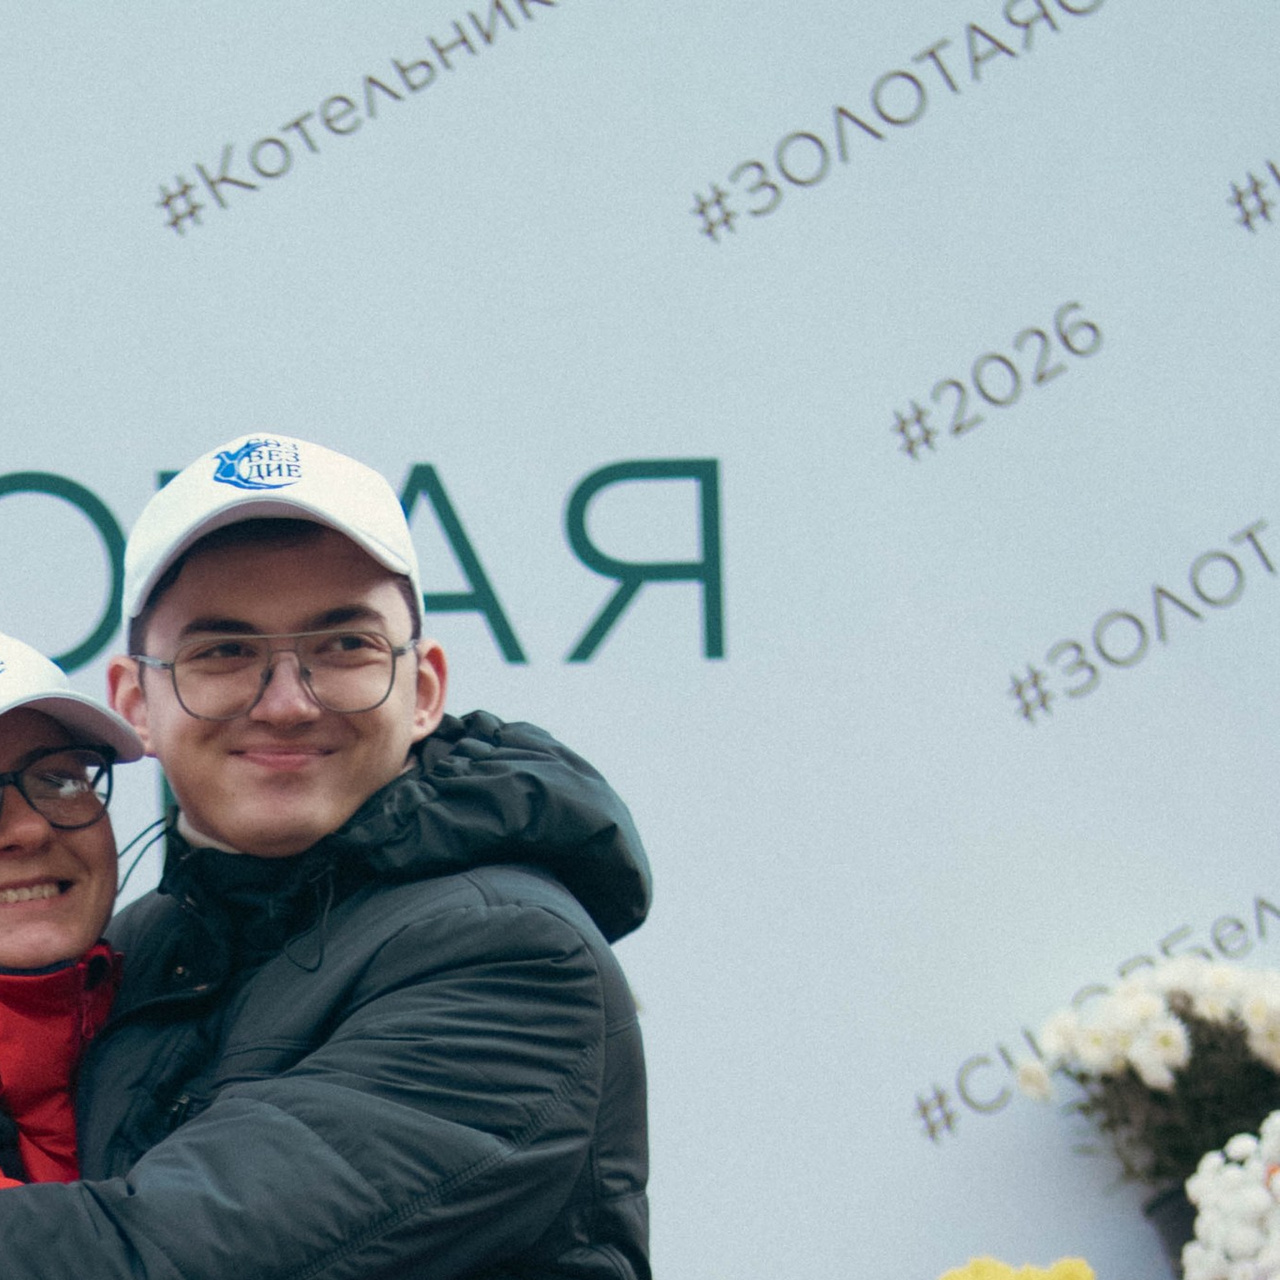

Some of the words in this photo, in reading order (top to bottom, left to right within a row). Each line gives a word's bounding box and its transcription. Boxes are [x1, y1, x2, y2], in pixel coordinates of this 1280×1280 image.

[892, 301, 1104, 460] #2026
[246, 463, 302, 480] ДИЕ
[247, 449, 300, 463] ВЕЗ
[1008, 519, 1278, 723] #ЗОЛОТ
